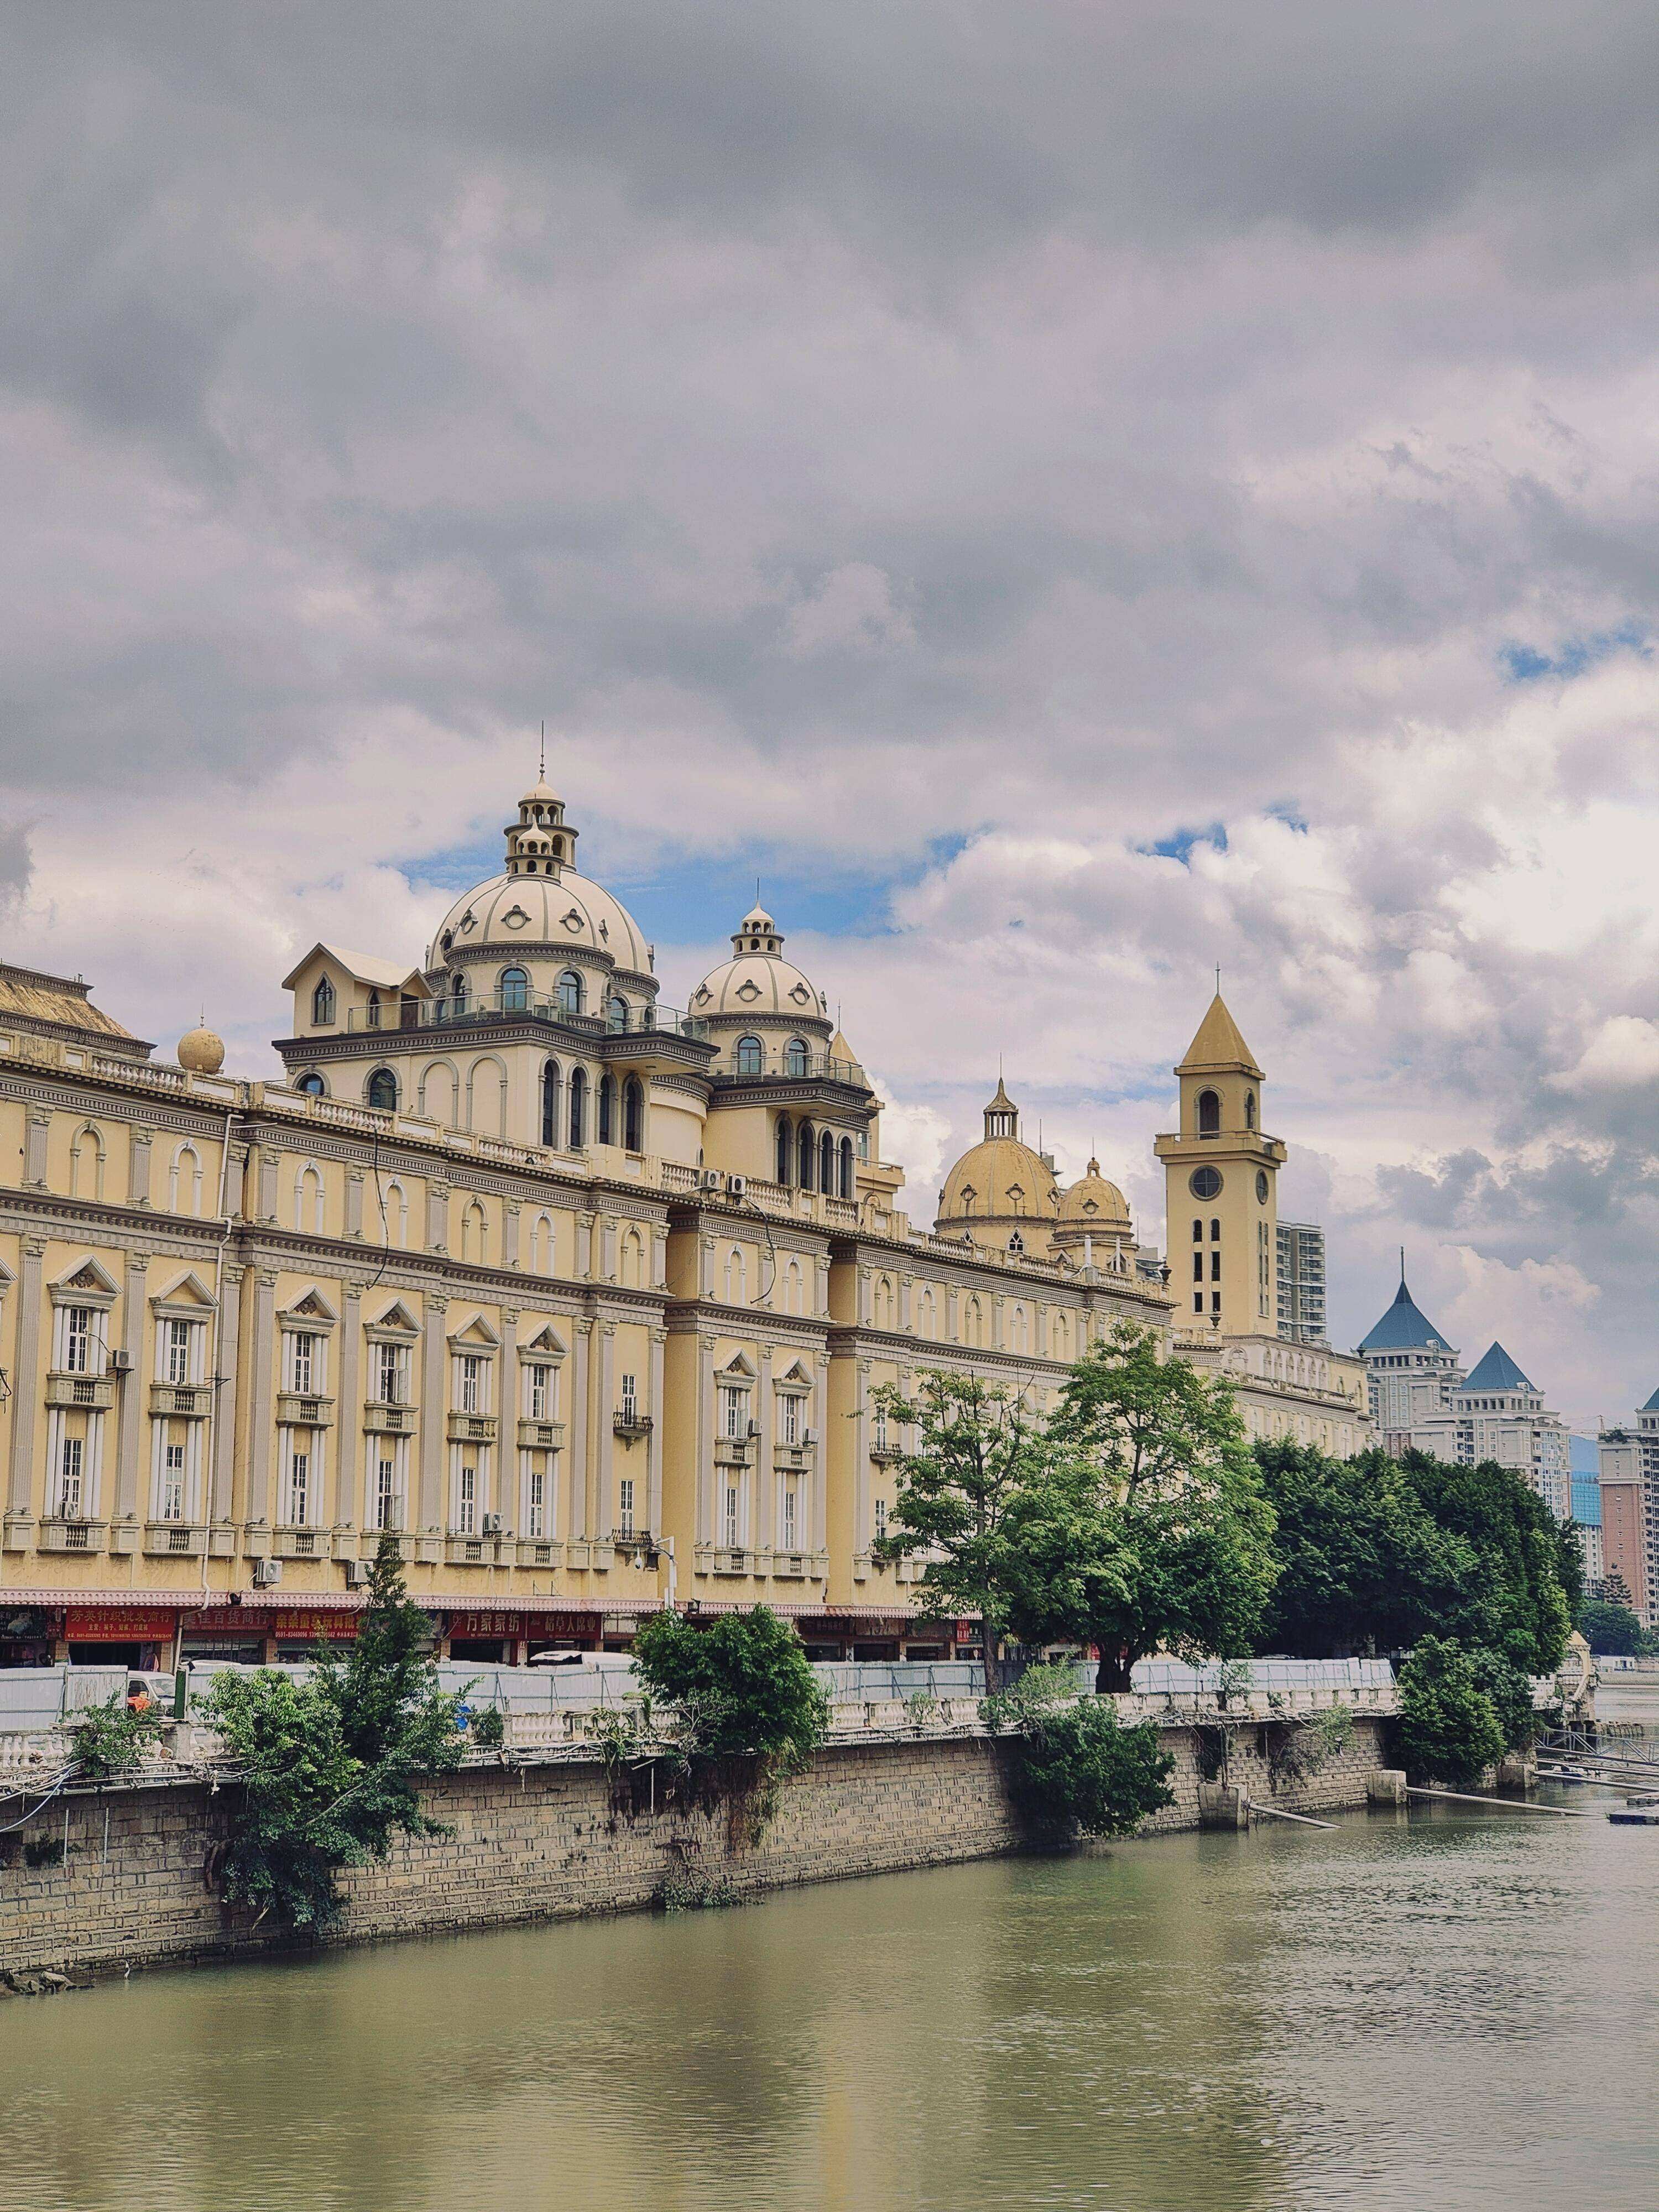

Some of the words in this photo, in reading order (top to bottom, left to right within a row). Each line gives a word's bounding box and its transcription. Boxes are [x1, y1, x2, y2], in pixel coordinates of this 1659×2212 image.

[71, 1609, 171, 1623] 芳英针织批发商行
[184, 1609, 269, 1625] 美佳百货商行
[467, 1613, 519, 1632] 万家家纺
